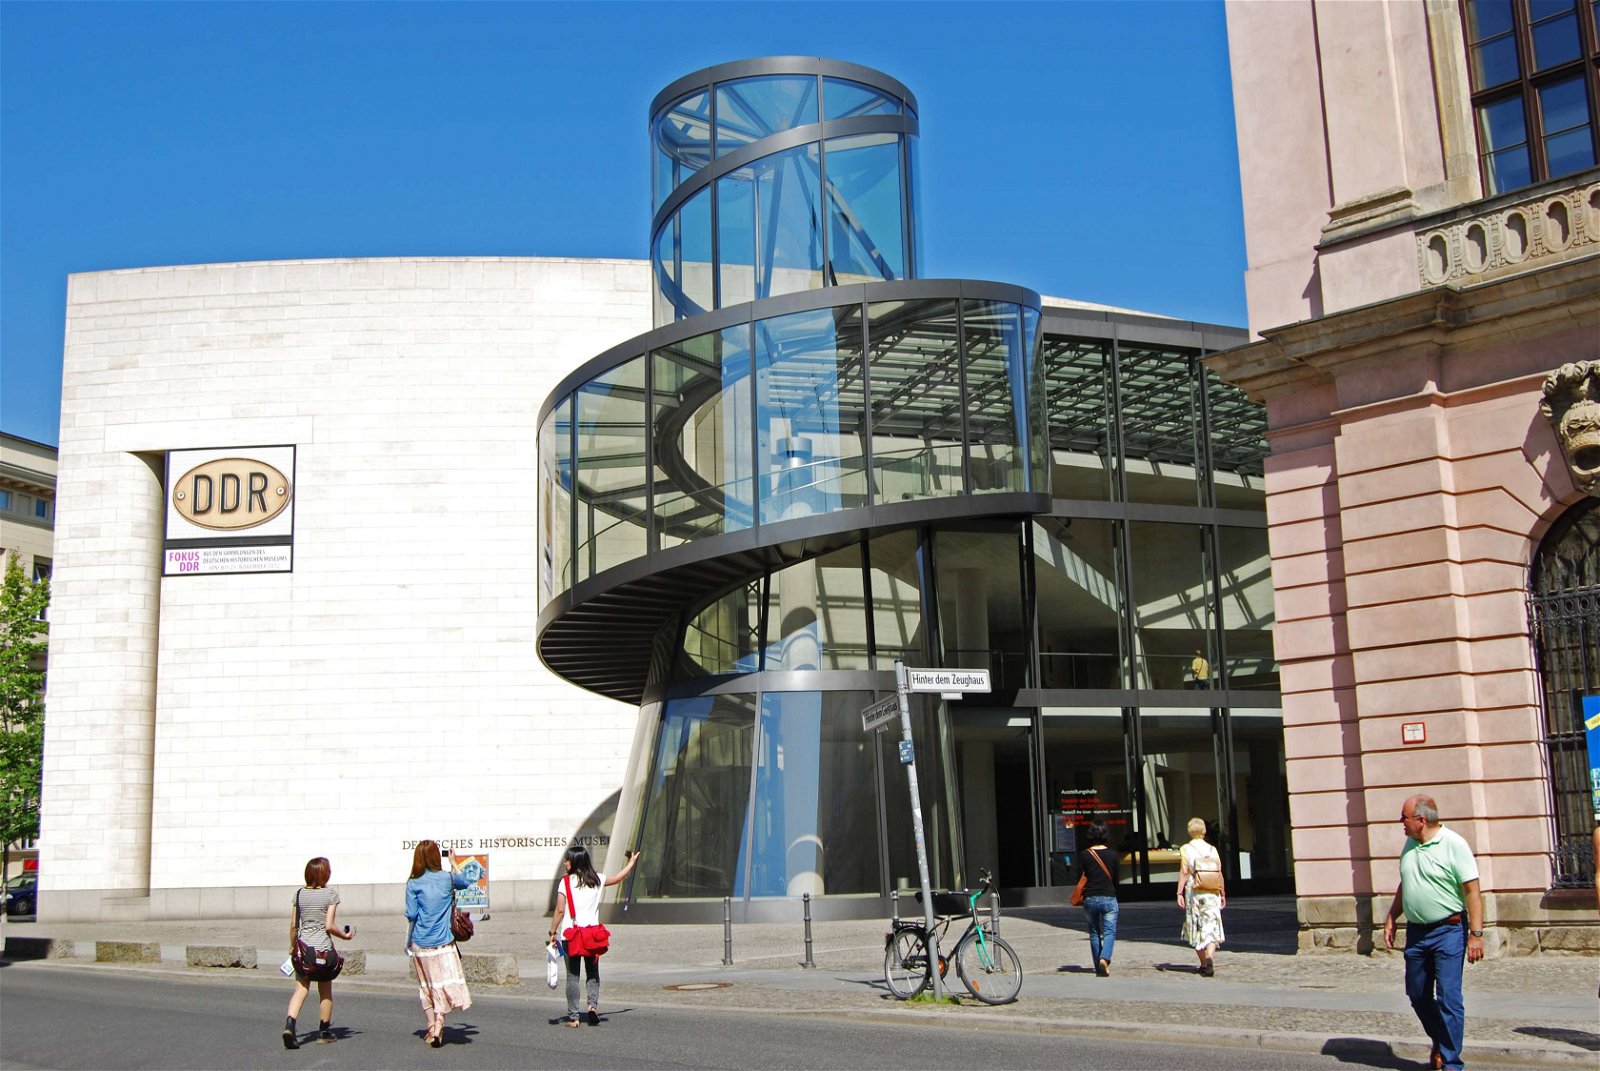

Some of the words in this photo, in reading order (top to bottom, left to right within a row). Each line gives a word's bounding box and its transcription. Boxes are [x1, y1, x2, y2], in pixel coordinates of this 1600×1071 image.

[192, 471, 268, 515] DDR
[169, 551, 200, 562] FOKUS
[179, 562, 199, 572] DDR
[912, 673, 934, 685] Hinter
[935, 673, 951, 685] dem
[951, 673, 985, 688] Zeughaus
[402, 838, 474, 850] DESCHES
[479, 836, 568, 849] HISTORISCHES
